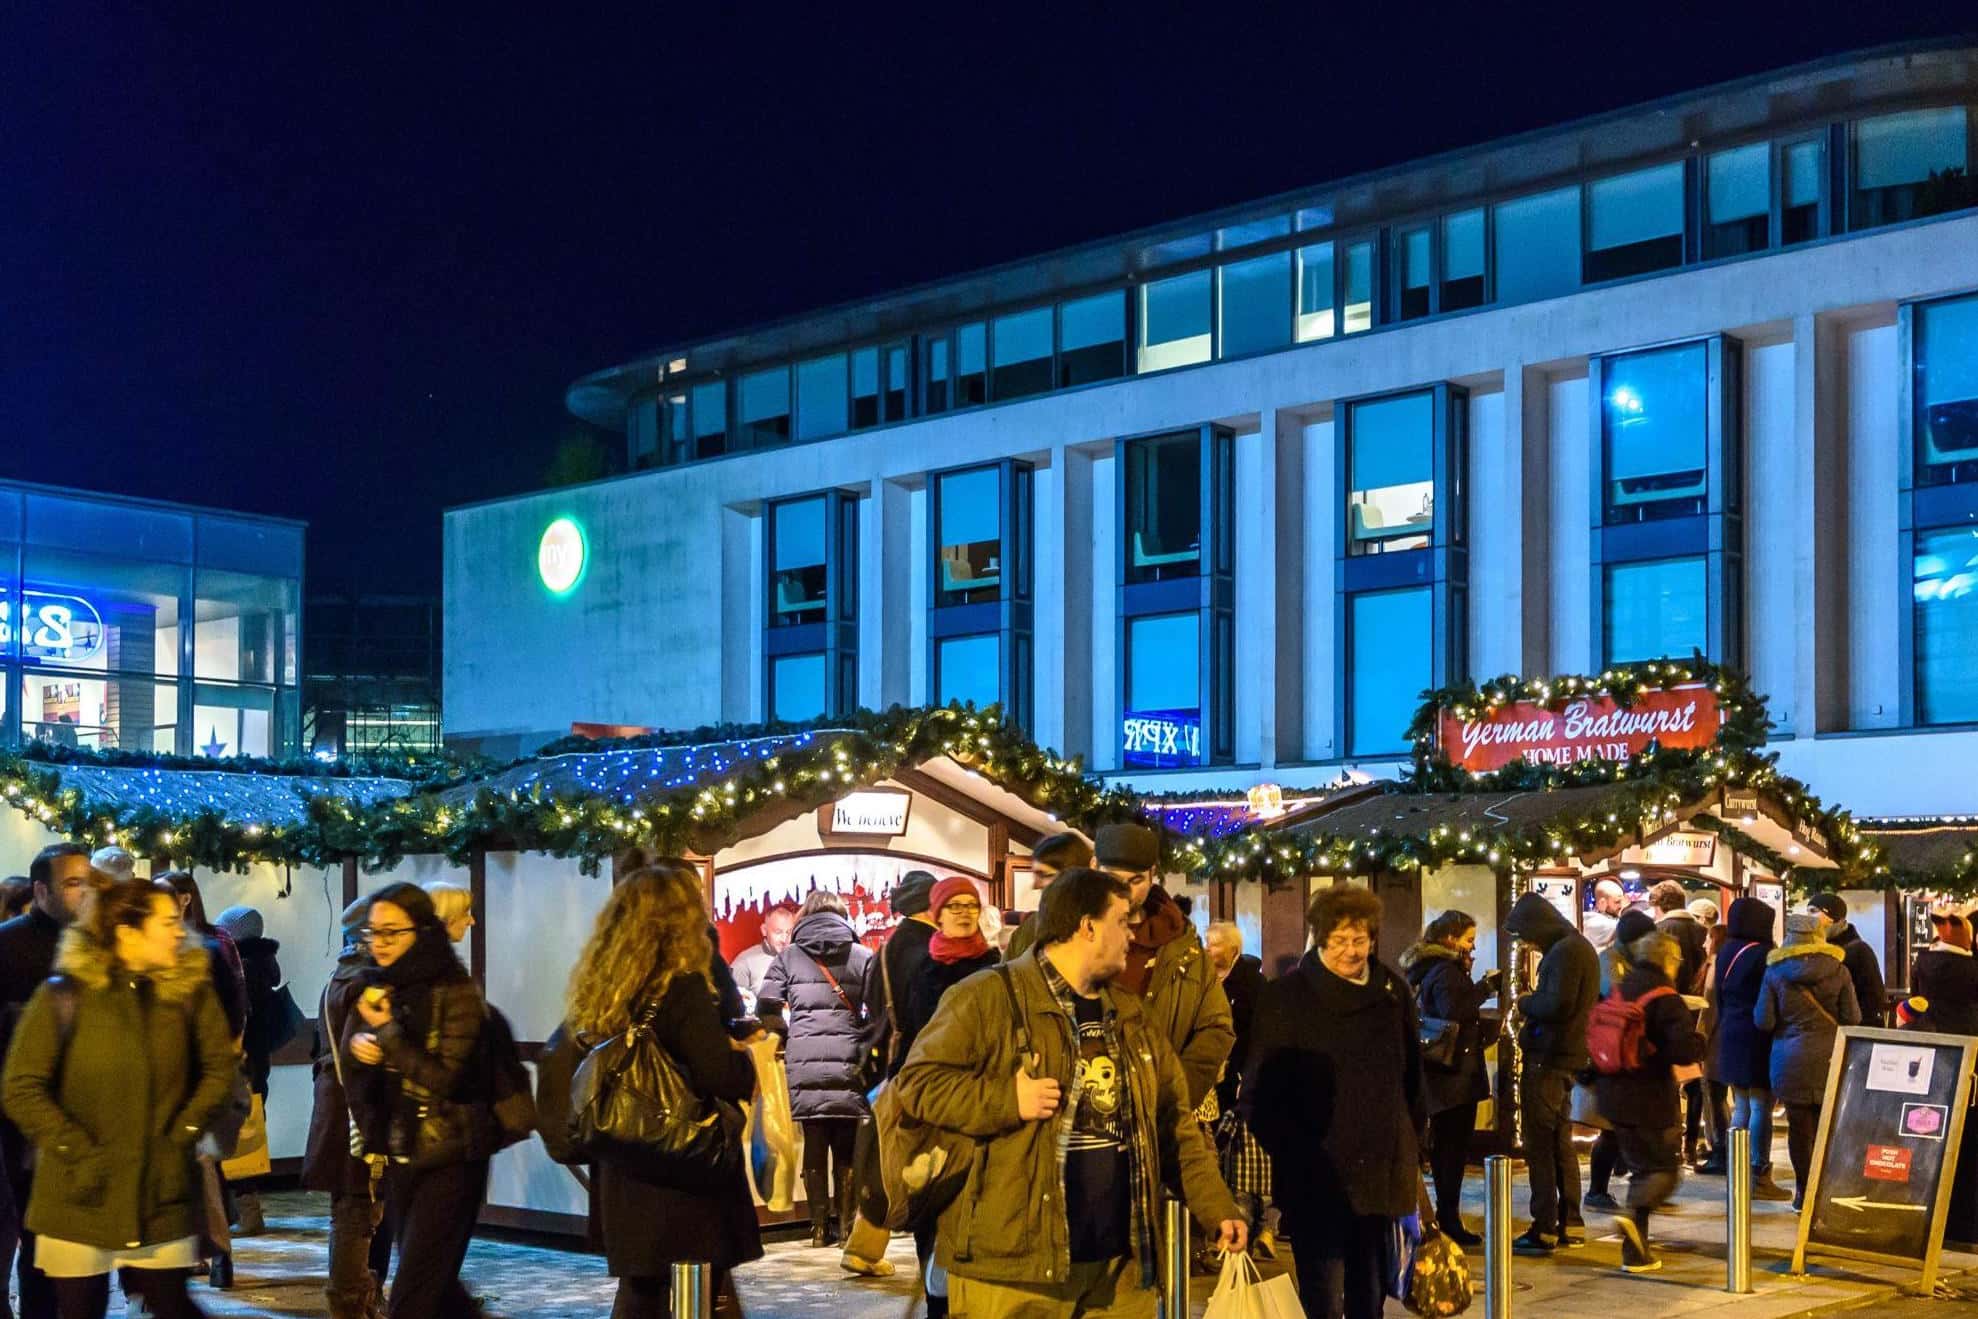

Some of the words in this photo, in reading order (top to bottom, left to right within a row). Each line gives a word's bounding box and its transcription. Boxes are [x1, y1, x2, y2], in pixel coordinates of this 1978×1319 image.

[1563, 701, 1696, 740] Bratwurst
[1522, 747, 1572, 767] HOME
[1725, 793, 1757, 814] Currywurst
